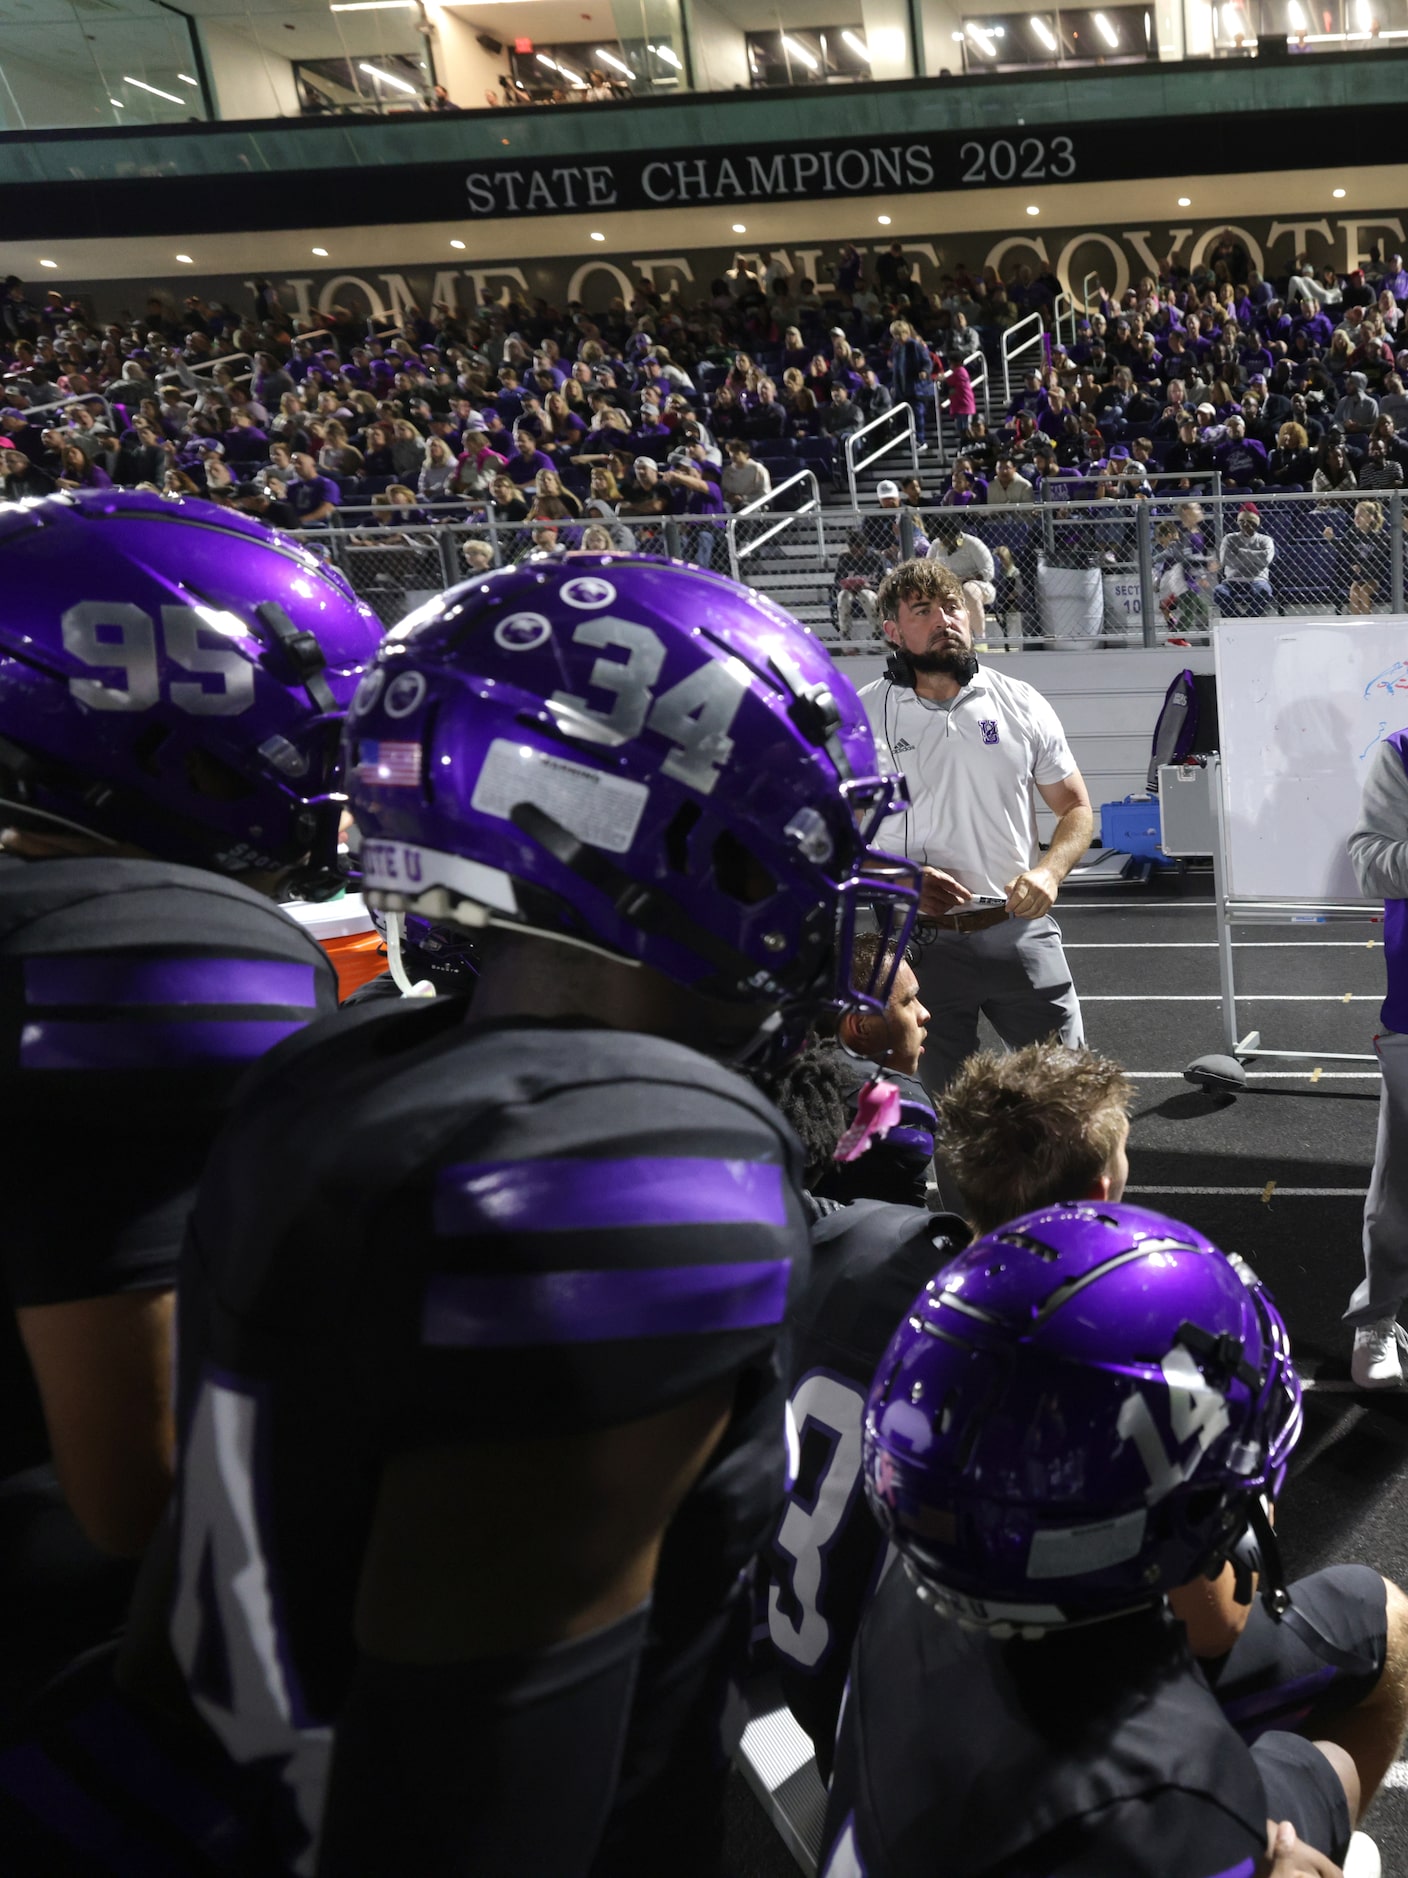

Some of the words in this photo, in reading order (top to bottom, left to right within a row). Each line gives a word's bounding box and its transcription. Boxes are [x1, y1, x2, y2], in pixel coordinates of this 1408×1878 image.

[466, 166, 617, 213] STATE
[641, 145, 934, 202] CHAMPIONS
[960, 136, 1077, 182] 2023
[61, 600, 256, 716] 95
[545, 616, 751, 794] 34
[1117, 1343, 1230, 1508] 14
